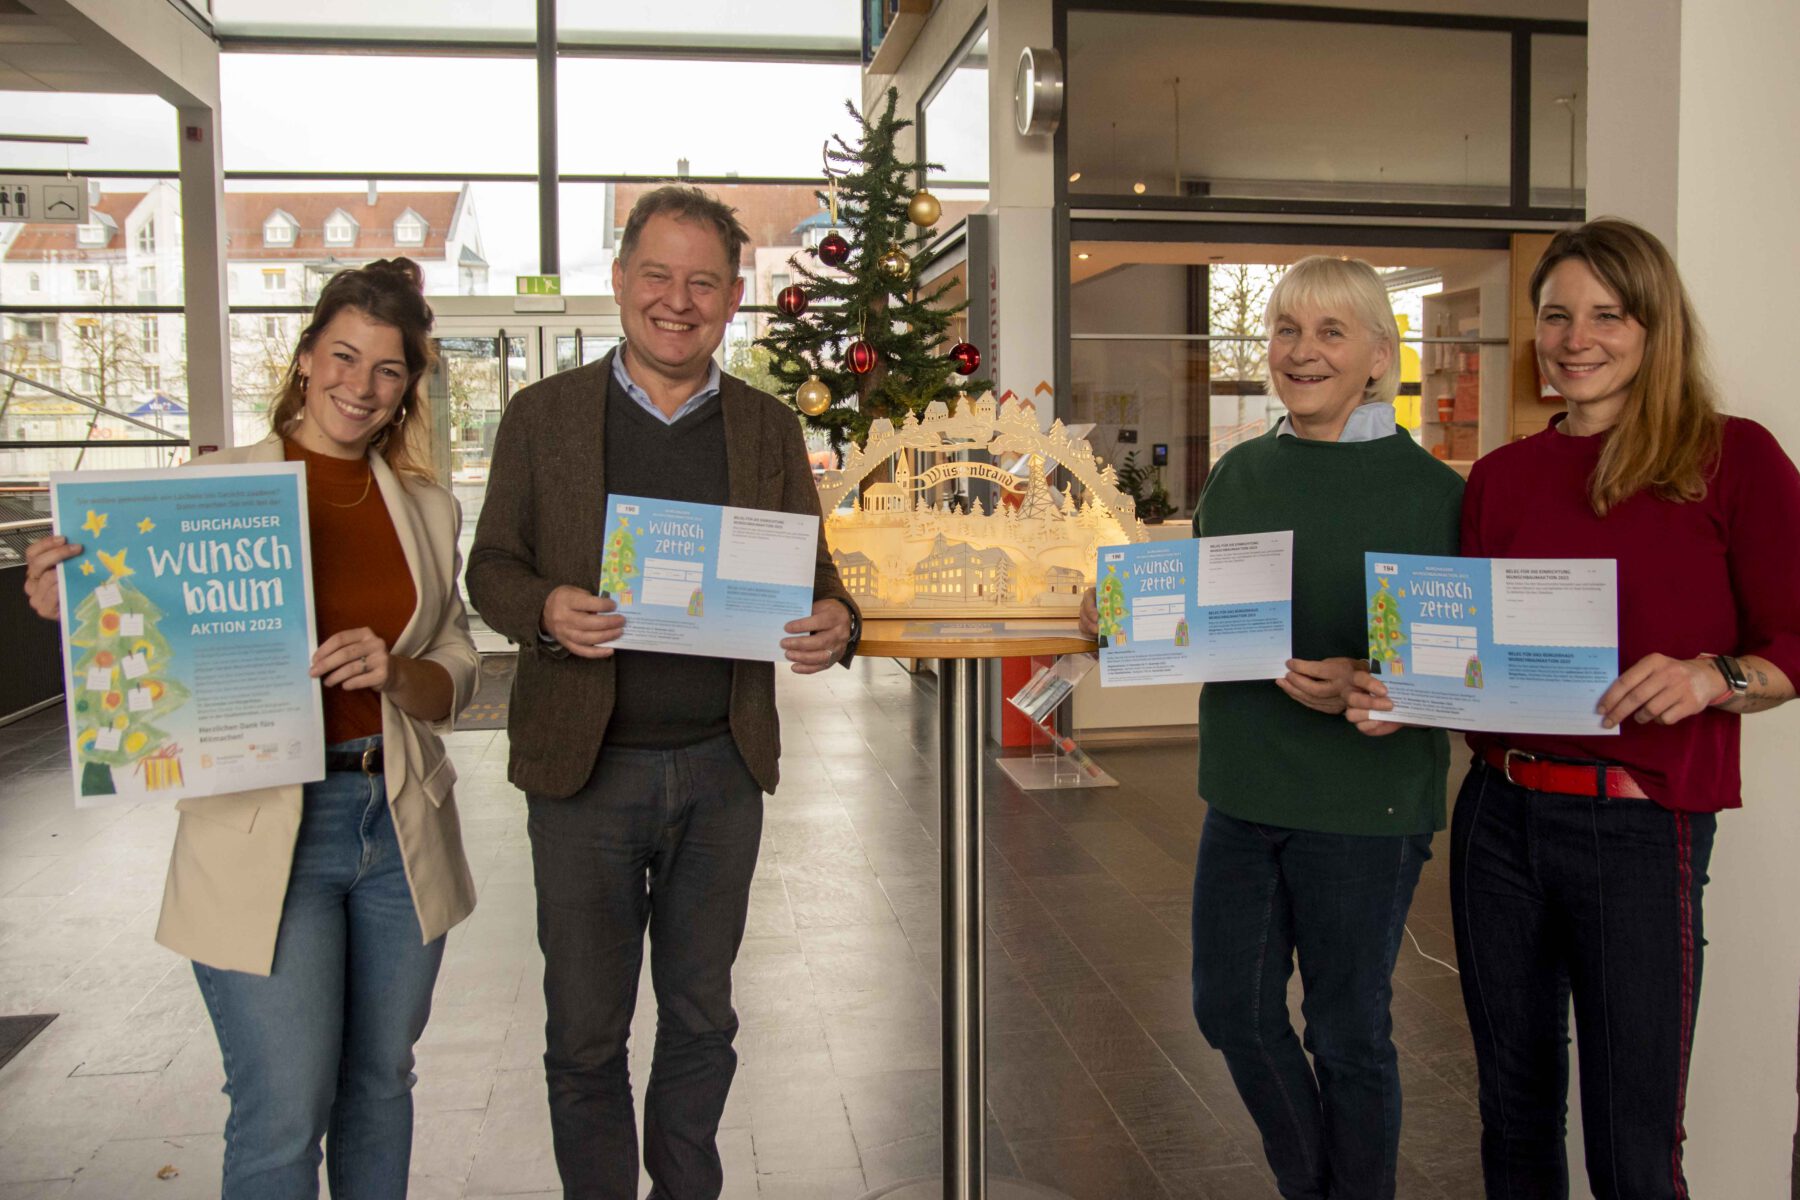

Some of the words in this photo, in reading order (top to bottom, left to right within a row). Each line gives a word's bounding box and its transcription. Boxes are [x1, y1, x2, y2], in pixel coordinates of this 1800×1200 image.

[925, 464, 1014, 487] Wüsnbrand
[181, 515, 281, 532] BURGHAUSER
[191, 621, 246, 636] AKTION
[249, 618, 282, 632] 2023
